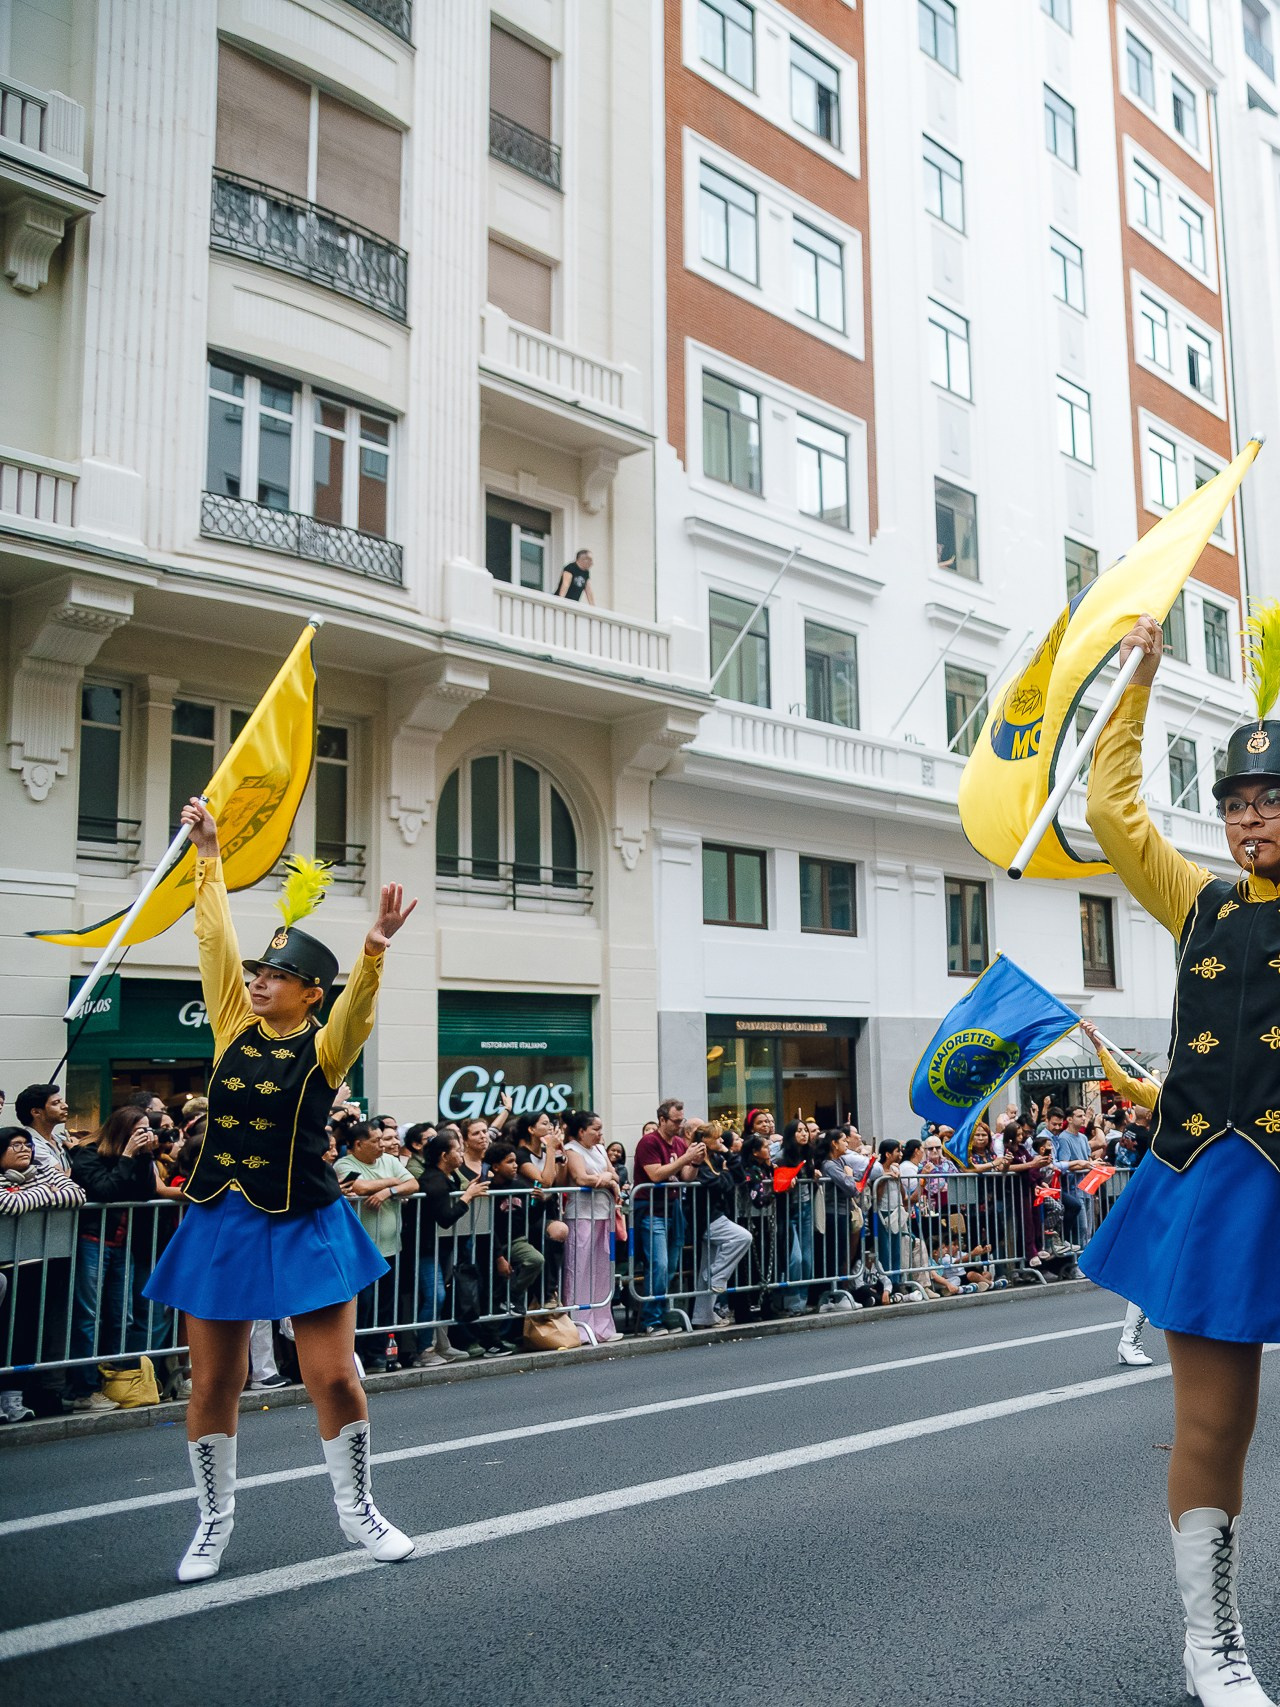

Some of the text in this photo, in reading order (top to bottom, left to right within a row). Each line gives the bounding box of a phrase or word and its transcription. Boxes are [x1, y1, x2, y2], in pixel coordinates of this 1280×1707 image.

[934, 1032, 997, 1073] MAJORETTES
[930, 1075, 941, 1085] Y
[1026, 1069, 1094, 1081] ESPAHOTEL
[439, 1065, 573, 1120] Ginos
